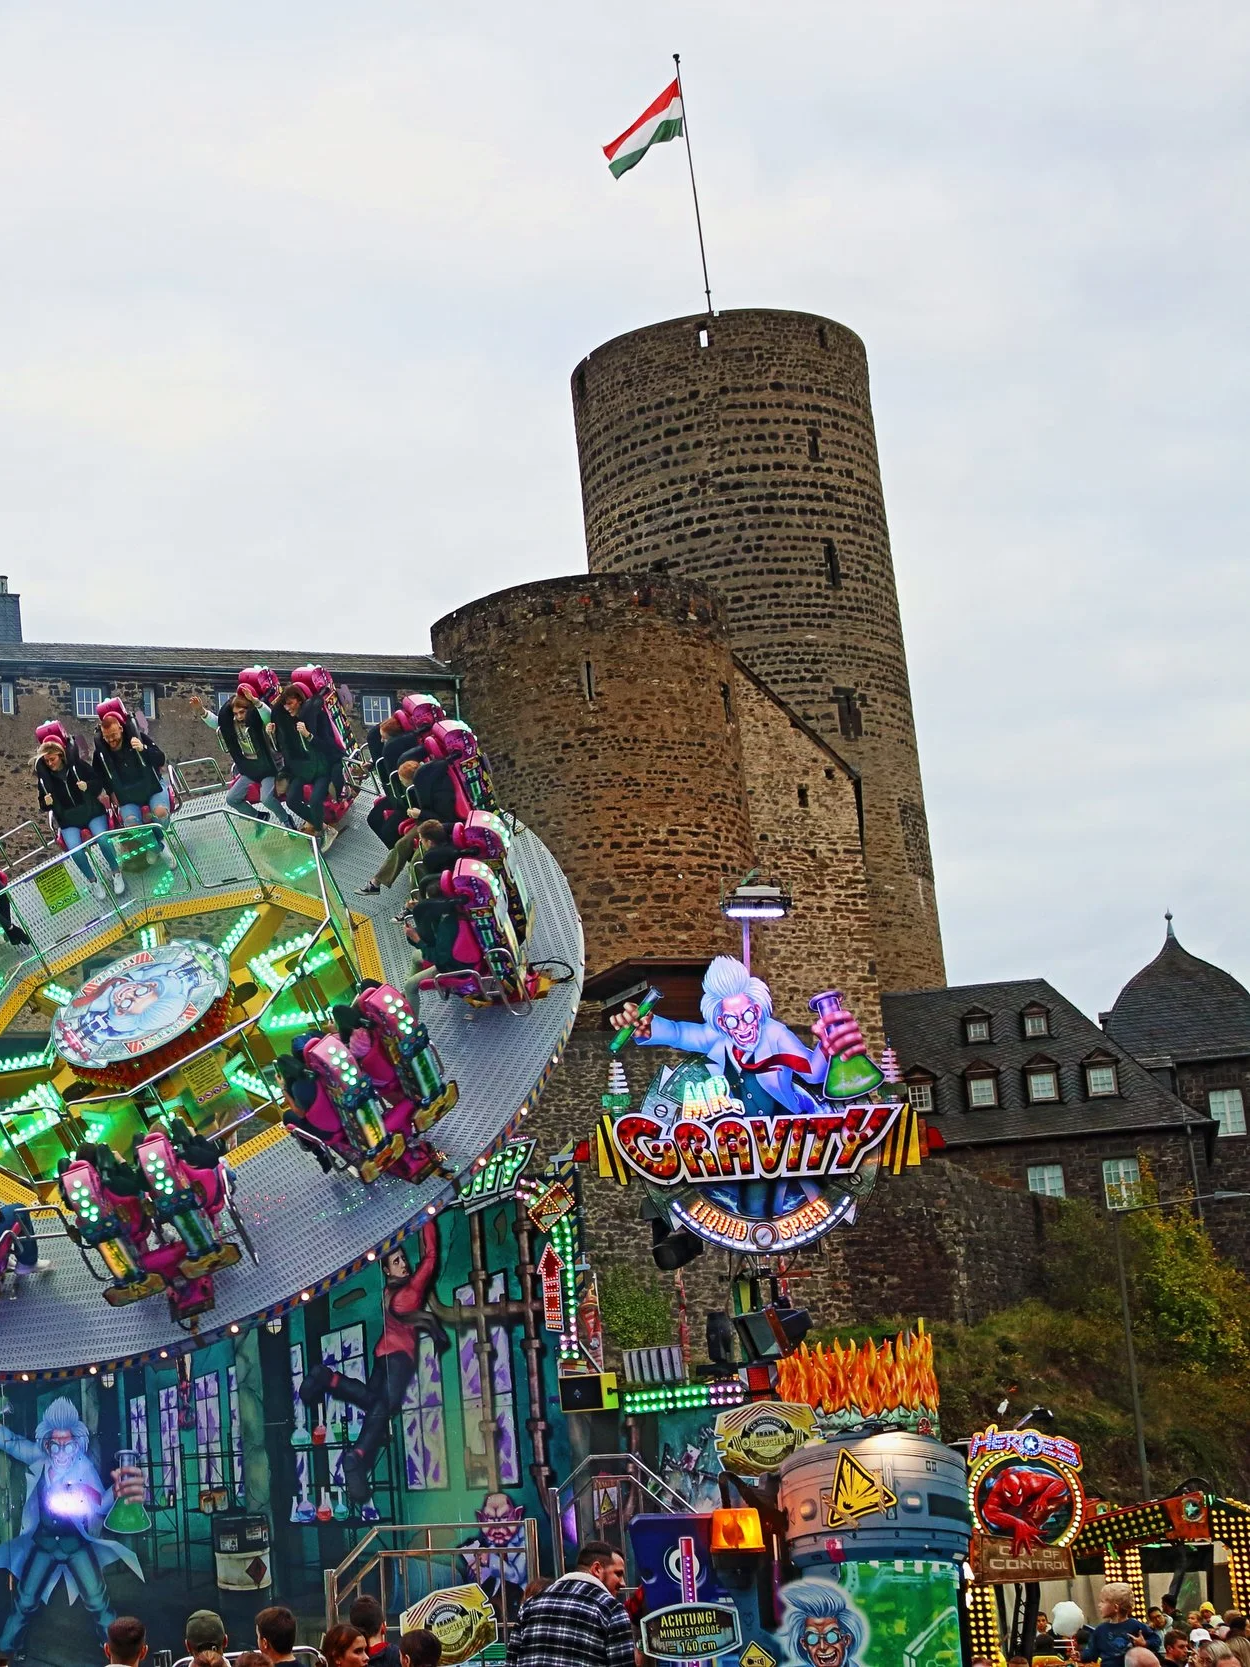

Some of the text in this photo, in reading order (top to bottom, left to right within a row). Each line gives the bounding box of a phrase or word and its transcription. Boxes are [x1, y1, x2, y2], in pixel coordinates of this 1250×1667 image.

[682, 1076, 746, 1122] MR.
[614, 1104, 900, 1184] GRAVITY
[689, 1198, 831, 1242] LIQUID SPEED
[969, 1427, 1080, 1468] HEROES
[989, 1558, 1068, 1571] CONTROL
[1043, 1547, 1060, 1558] OF
[660, 1610, 717, 1628] ACHTUNG!
[680, 1640, 699, 1654] 140
[701, 1641, 717, 1651] cm
